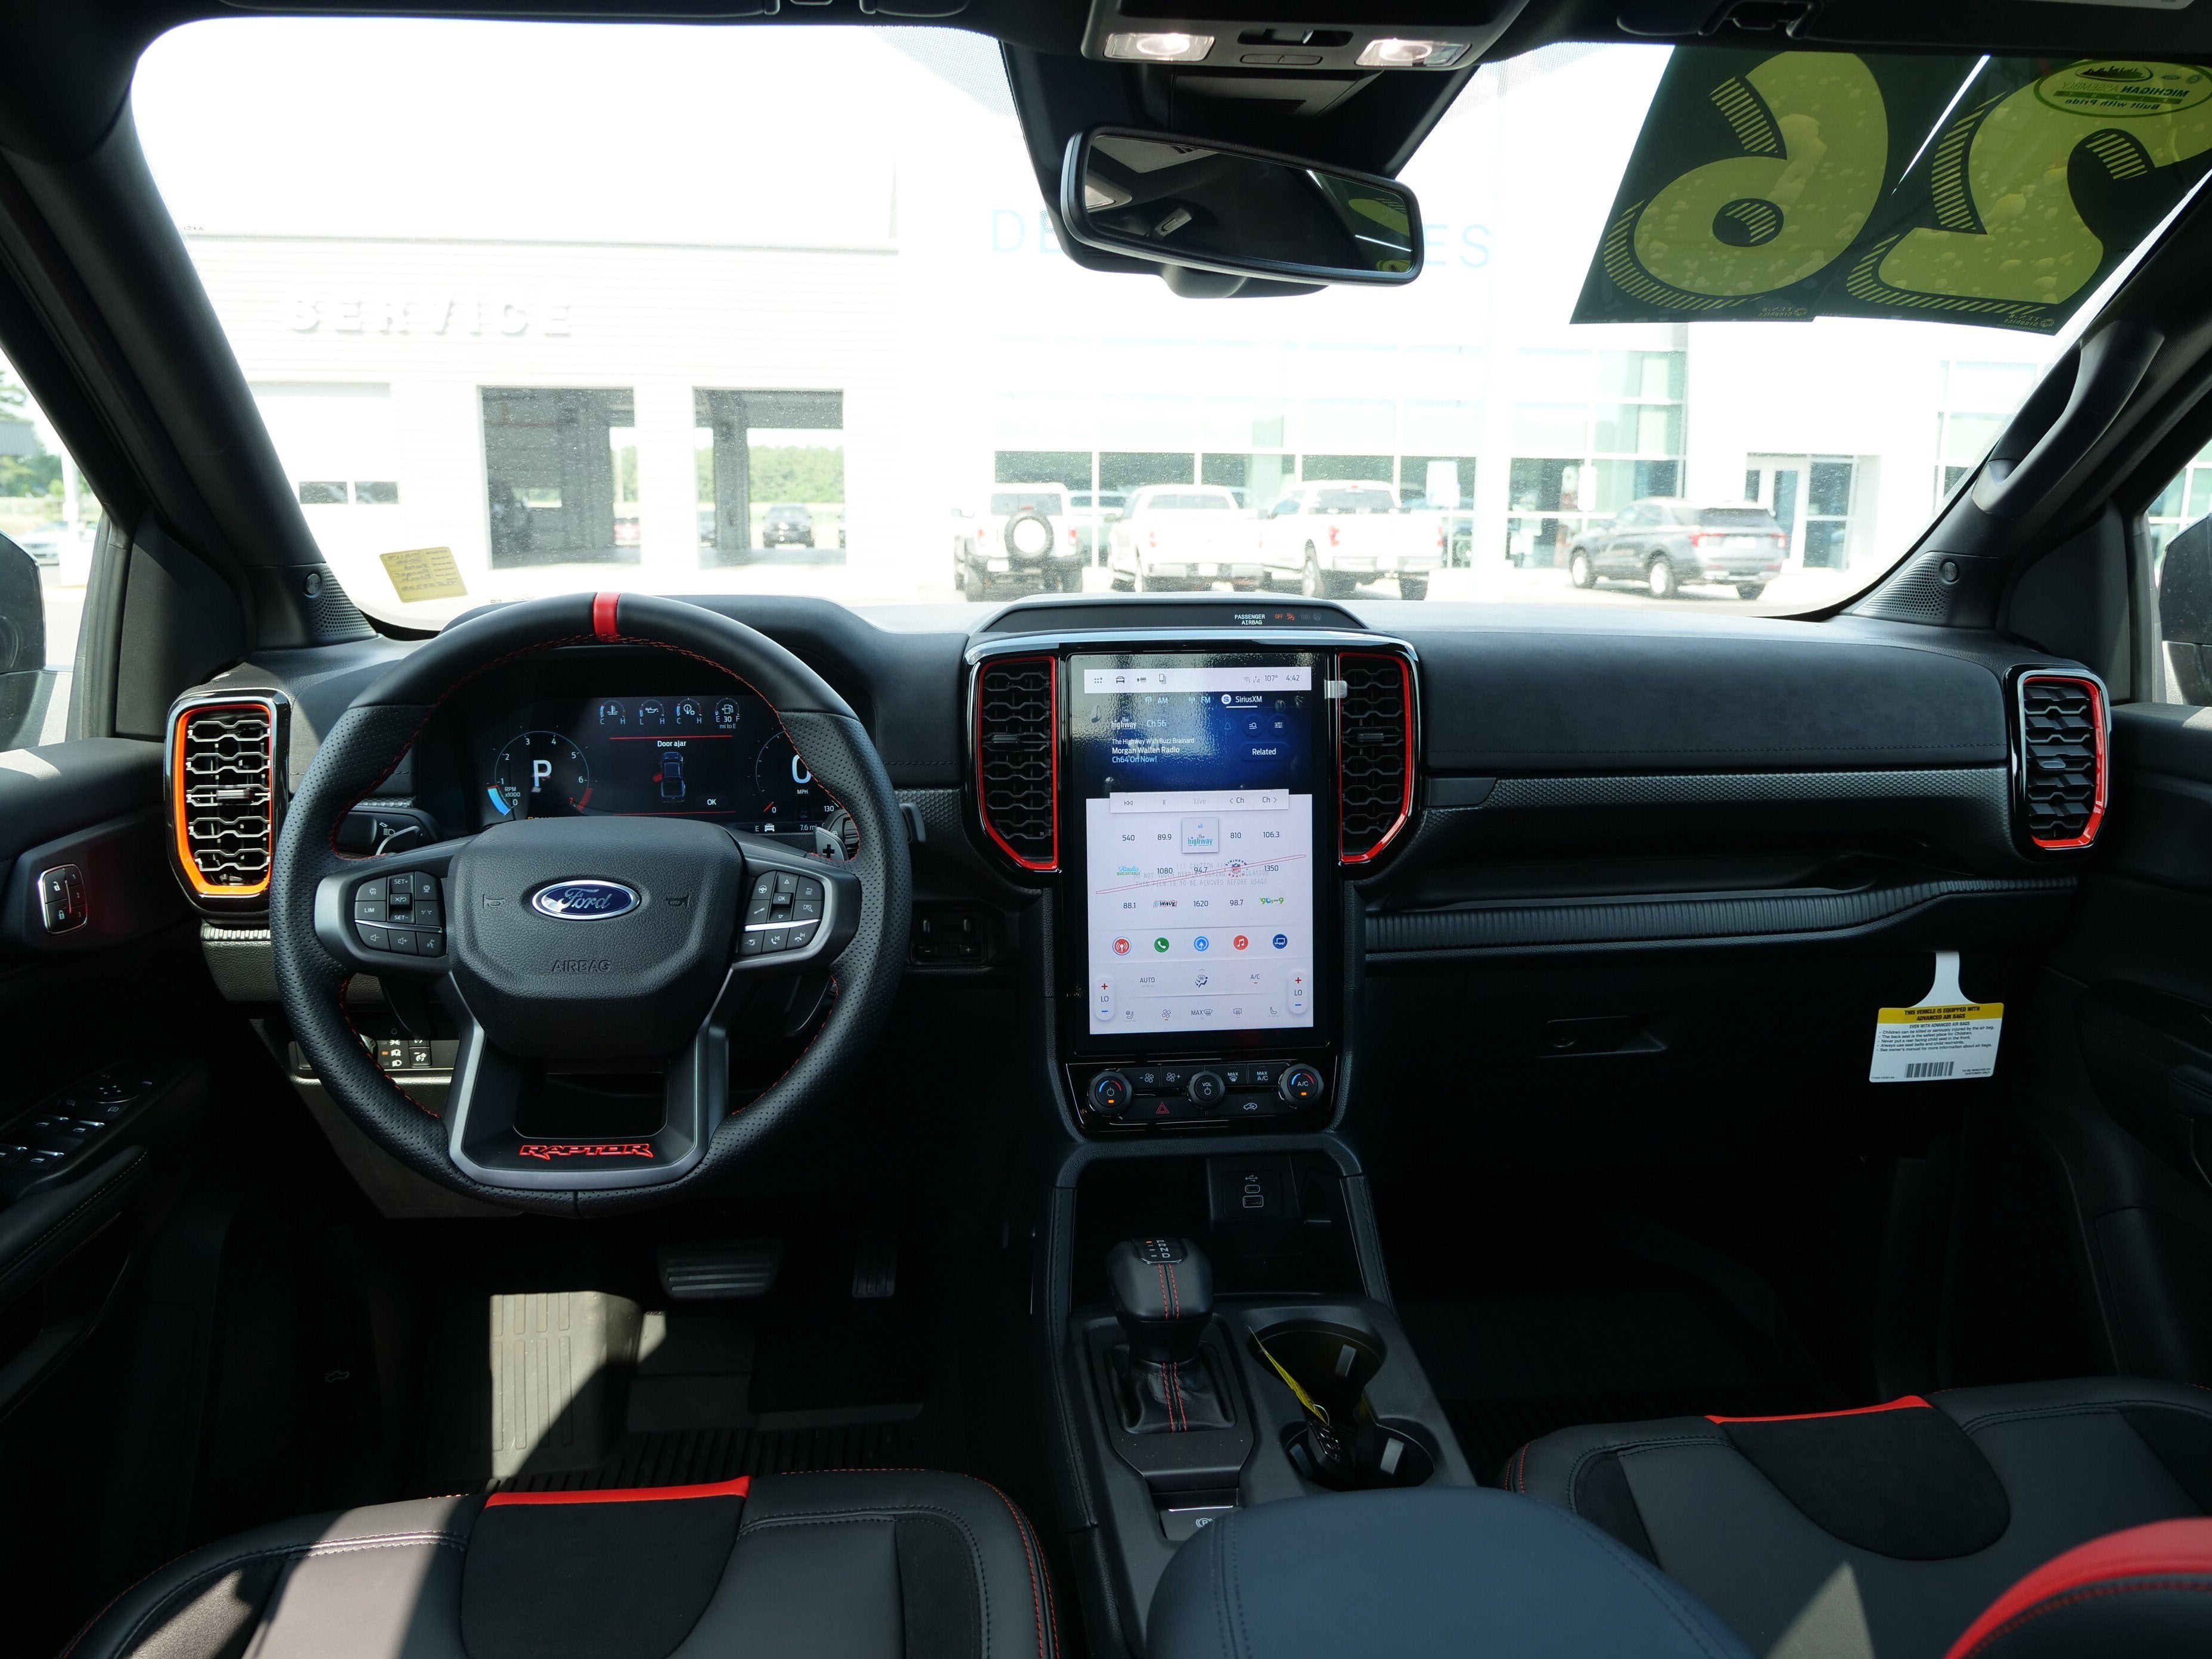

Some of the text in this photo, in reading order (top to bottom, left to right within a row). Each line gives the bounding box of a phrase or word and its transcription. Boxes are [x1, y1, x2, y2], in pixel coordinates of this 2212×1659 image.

[289, 296, 572, 338] SERVICE
[1111, 720, 1137, 730] highway
[1112, 747, 1136, 756] Morgan
[535, 760, 552, 787] P
[1188, 837, 1213, 846] highway
[551, 886, 612, 912] Ford
[552, 959, 612, 973] AIRBAG
[519, 1142, 655, 1161] RAPTOR
